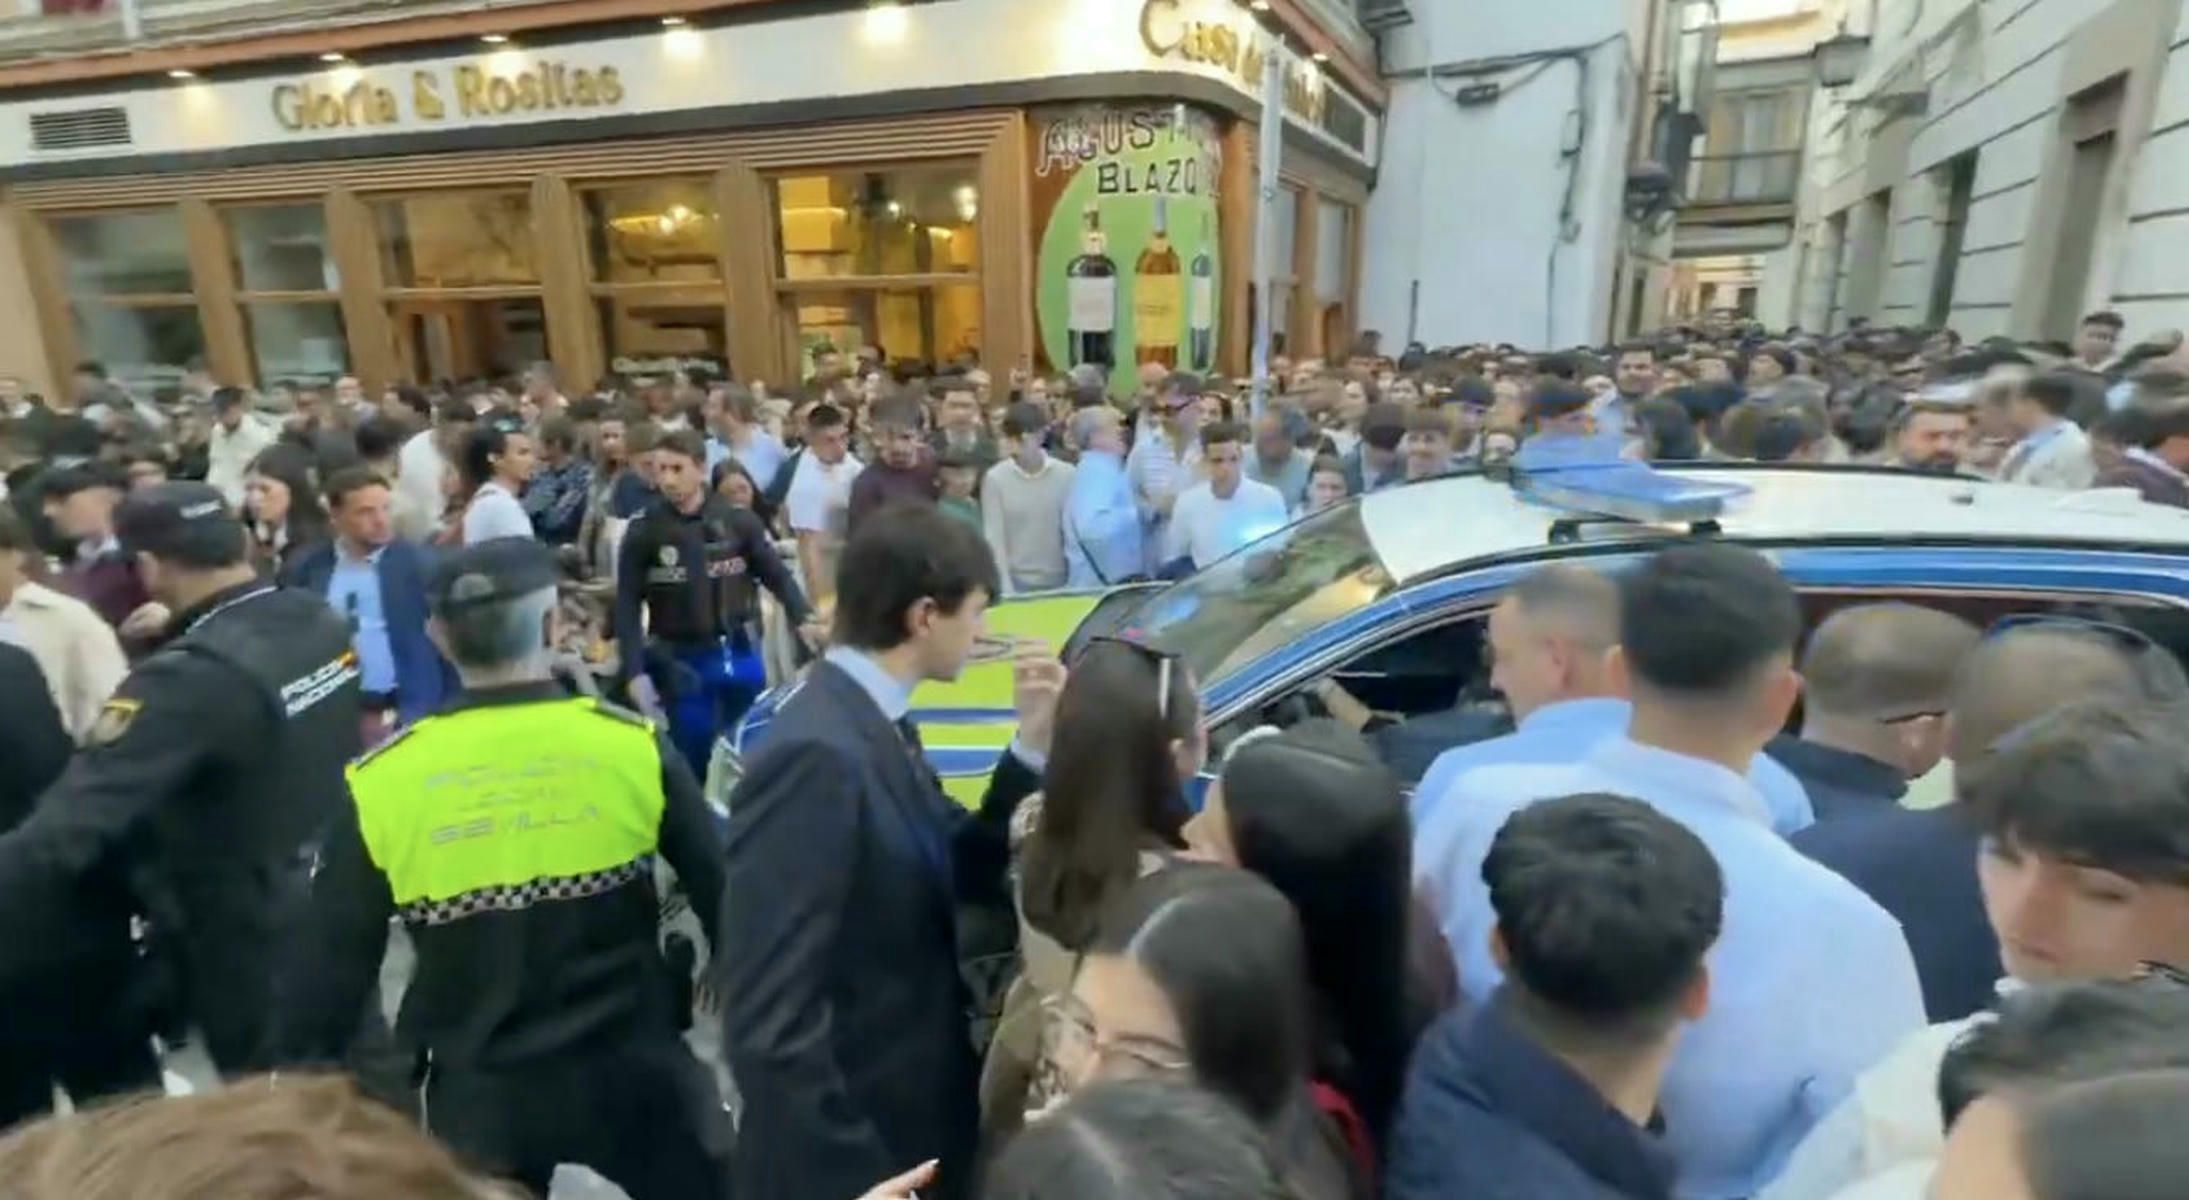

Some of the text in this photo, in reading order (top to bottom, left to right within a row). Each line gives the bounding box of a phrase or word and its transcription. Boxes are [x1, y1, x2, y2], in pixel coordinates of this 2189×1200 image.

[1139, 0, 1238, 73] Casa
[271, 60, 623, 131] Gloria & Rositas
